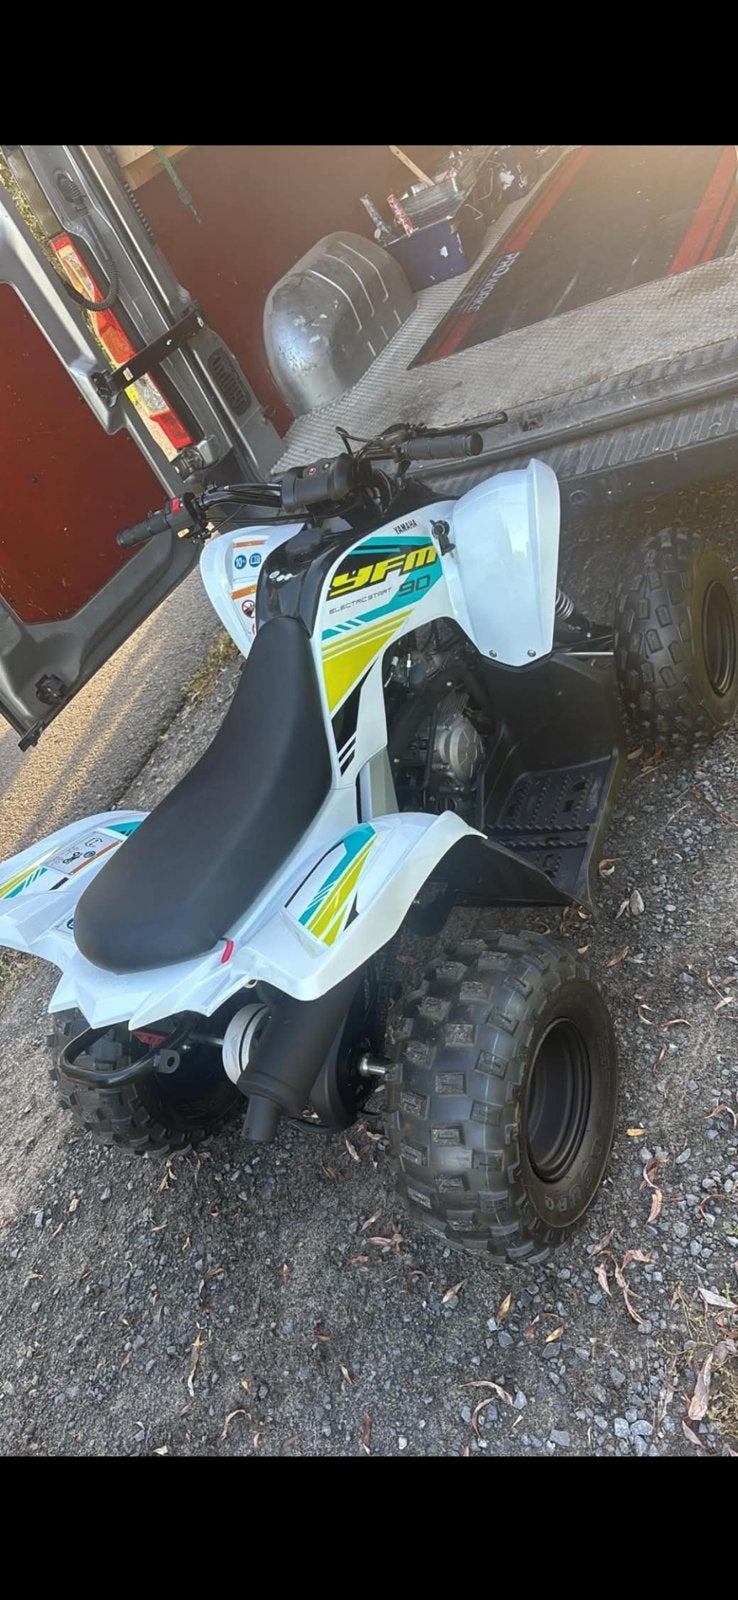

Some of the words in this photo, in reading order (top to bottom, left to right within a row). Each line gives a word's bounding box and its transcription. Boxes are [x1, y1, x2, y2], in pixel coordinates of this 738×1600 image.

[492, 251, 520, 277] PRO
[393, 519, 417, 535] YAMAHA
[327, 545, 438, 599] YFM
[398, 574, 431, 598] 90
